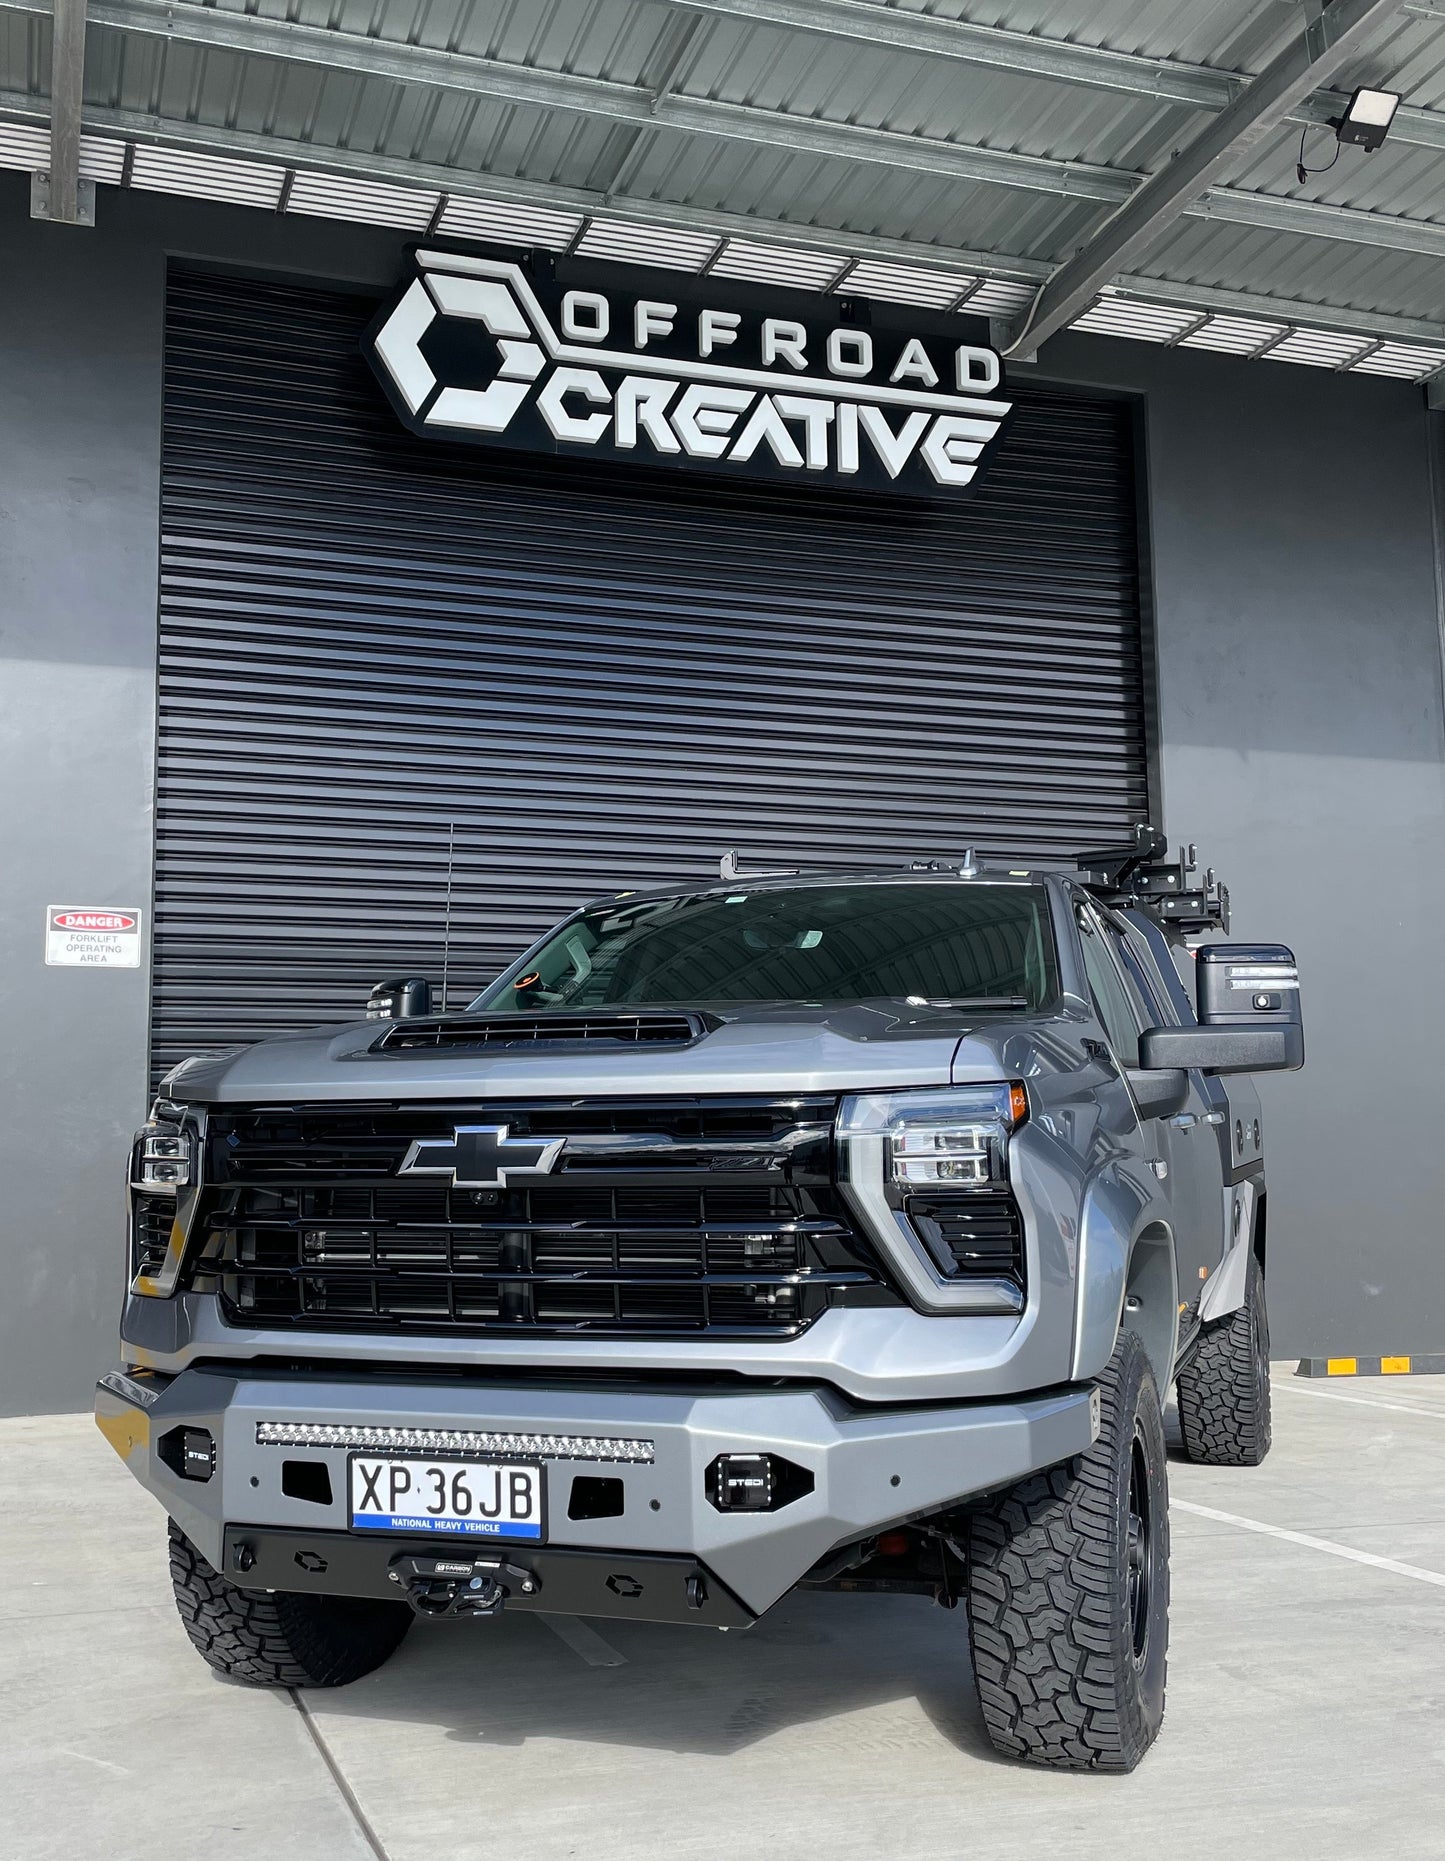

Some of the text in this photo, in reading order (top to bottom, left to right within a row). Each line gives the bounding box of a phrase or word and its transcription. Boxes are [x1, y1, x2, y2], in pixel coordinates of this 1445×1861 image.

[561, 290, 1001, 393] OFFROAD
[536, 366, 1001, 487] CREATIVE
[65, 915, 123, 928] DANGER
[70, 934, 118, 943] FORKLIFT
[66, 943, 122, 953] OPERATING
[80, 954, 108, 963] AREA
[728, 1478, 764, 1487] STEDI
[391, 1517, 501, 1533] NATIONAL HEAVY VEHICLE
